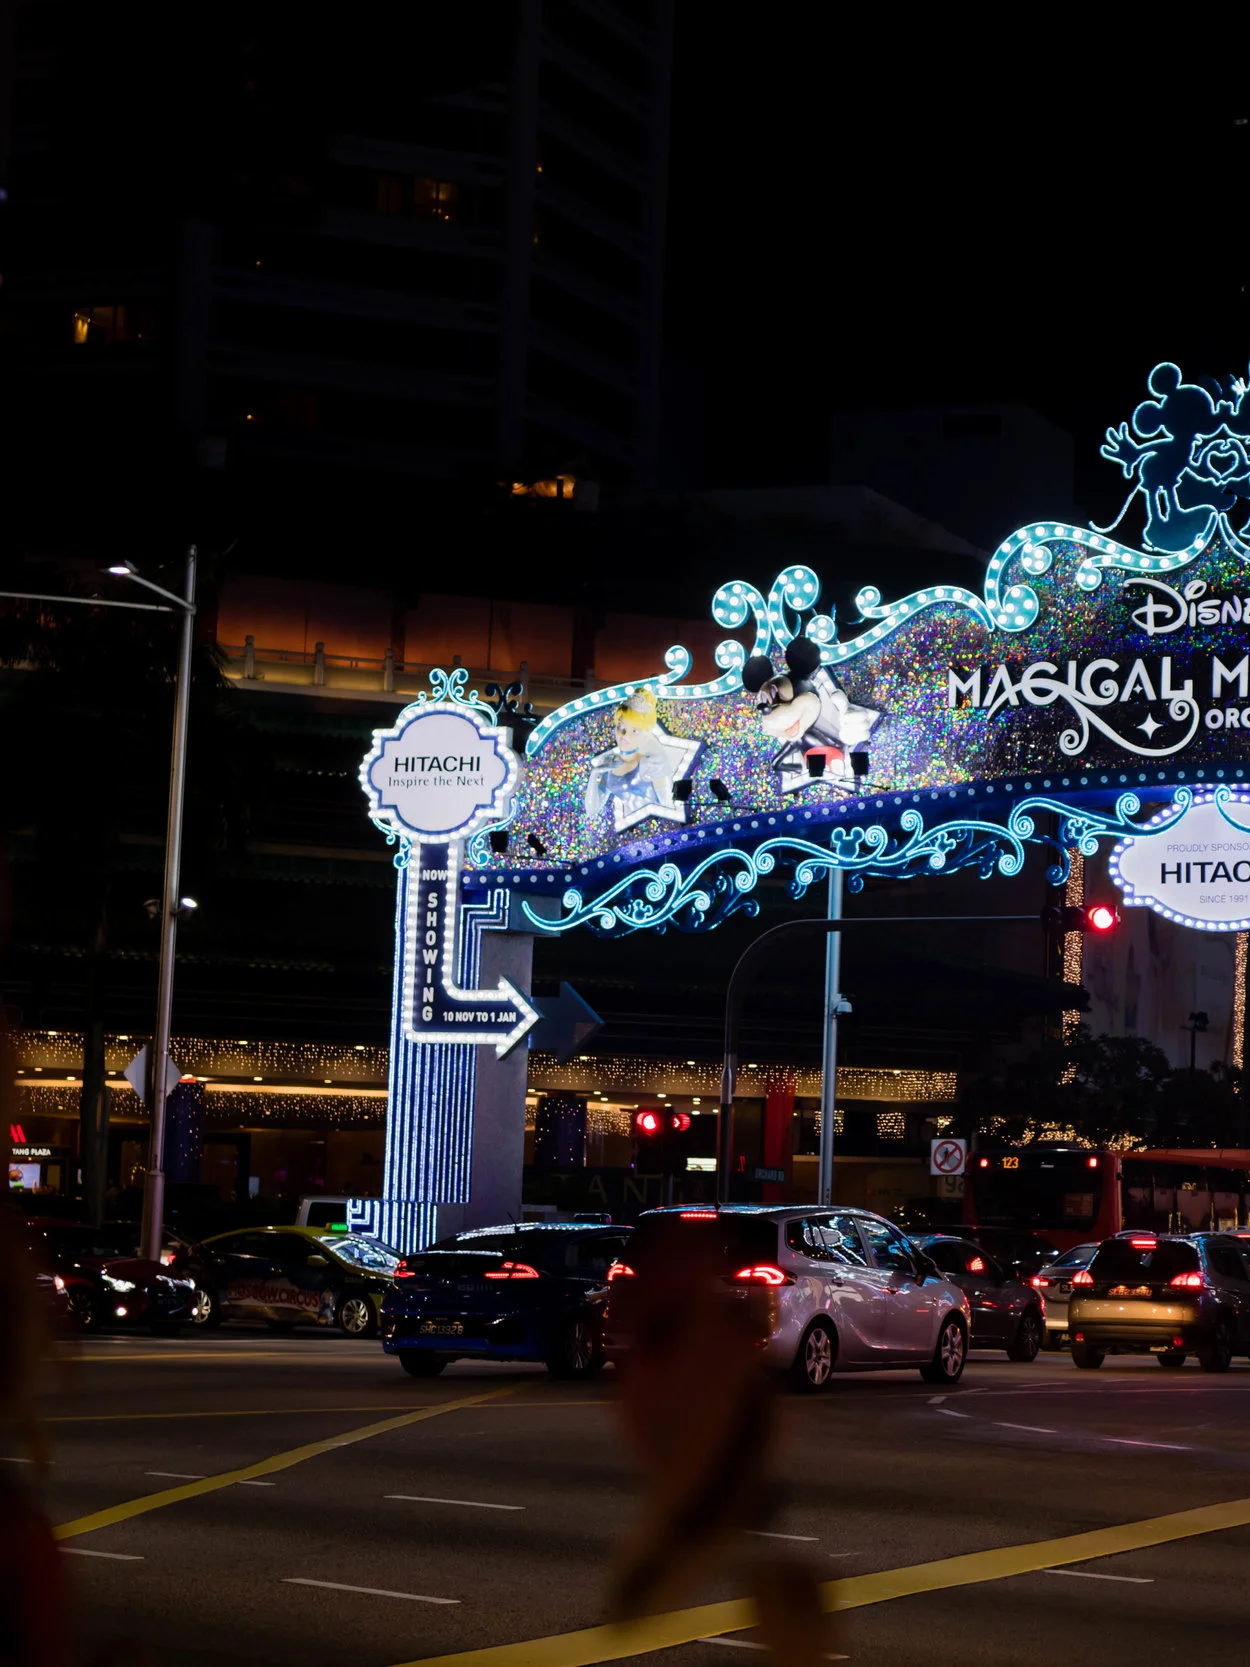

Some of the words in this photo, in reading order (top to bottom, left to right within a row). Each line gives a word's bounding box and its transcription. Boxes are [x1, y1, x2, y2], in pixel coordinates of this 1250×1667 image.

[949, 656, 1200, 752] MAGICAL
[394, 756, 480, 772] HITACHI
[388, 776, 427, 788] Inspire
[433, 776, 453, 786] the
[456, 775, 484, 786] Next
[1167, 844, 1208, 853] PROUDLY
[422, 869, 447, 881] NOW
[1199, 895, 1227, 904] SINCE
[1230, 894, 1249, 903] 1991
[422, 892, 439, 1021] SHOWING
[443, 1011, 454, 1022] 10
[455, 1011, 475, 1022] NOV
[476, 1011, 489, 1022] TO
[490, 1012, 496, 1022] 1
[497, 1012, 517, 1022] JAN
[1002, 1157, 1019, 1169] 123
[279, 1288, 319, 1307] CIRCUS
